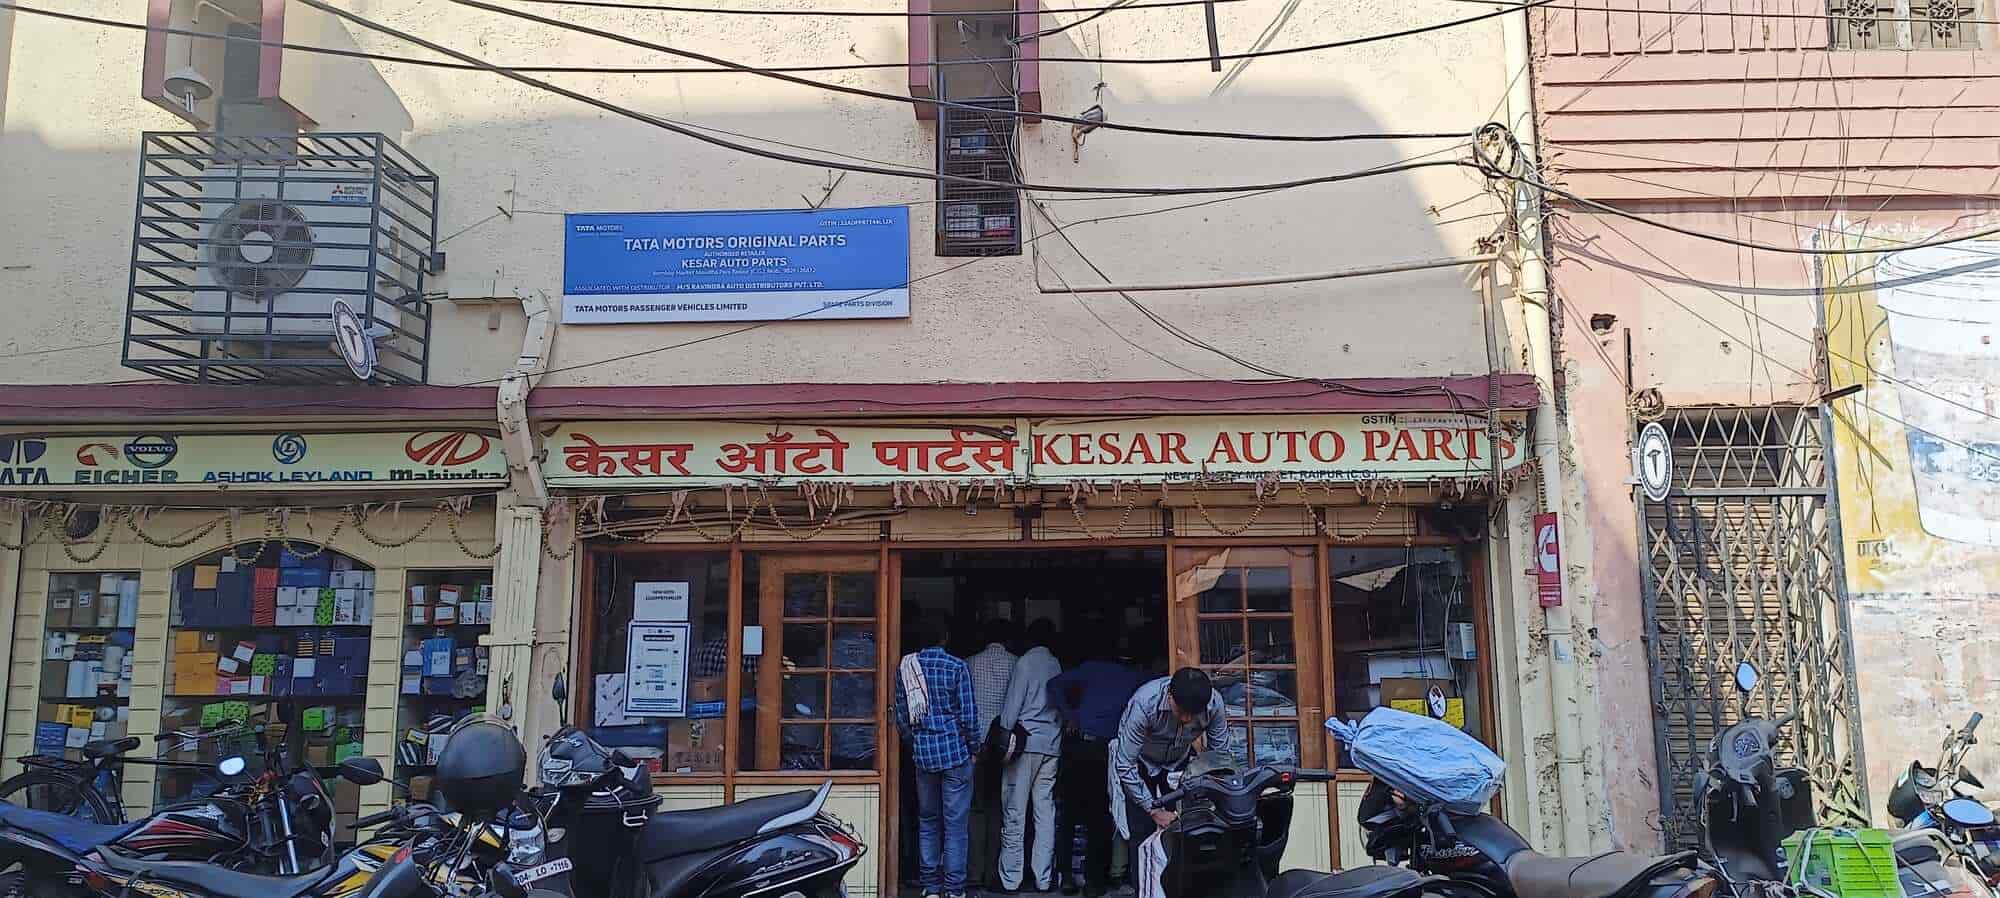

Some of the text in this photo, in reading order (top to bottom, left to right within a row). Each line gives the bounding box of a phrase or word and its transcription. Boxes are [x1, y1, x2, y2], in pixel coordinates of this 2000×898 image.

[624, 234, 847, 251] TATA MOTORS ORIGINAL PARTS
[681, 257, 788, 269] KESAR AUTO PARTS
[575, 305, 594, 313] TATA
[629, 304, 676, 312] PASSENGER
[677, 303, 715, 311] VEHICLES
[716, 303, 748, 311] LIMITED
[1361, 415, 1397, 425] GSTIN
[128, 445, 174, 453] VOLVO
[563, 432, 694, 476] केसर
[716, 428, 849, 474] ऑटो
[1031, 428, 1517, 465] KESAR AUTO PARTS
[0, 467, 49, 485] ATA
[75, 470, 178, 485] EICHER
[203, 470, 372, 483] ASHOK LEYLAND
[389, 469, 504, 481] Mahindra
[1164, 471, 1191, 480] NEW
[1246, 471, 1295, 480] MAET,
[1300, 470, 1344, 480] RAIPUR
